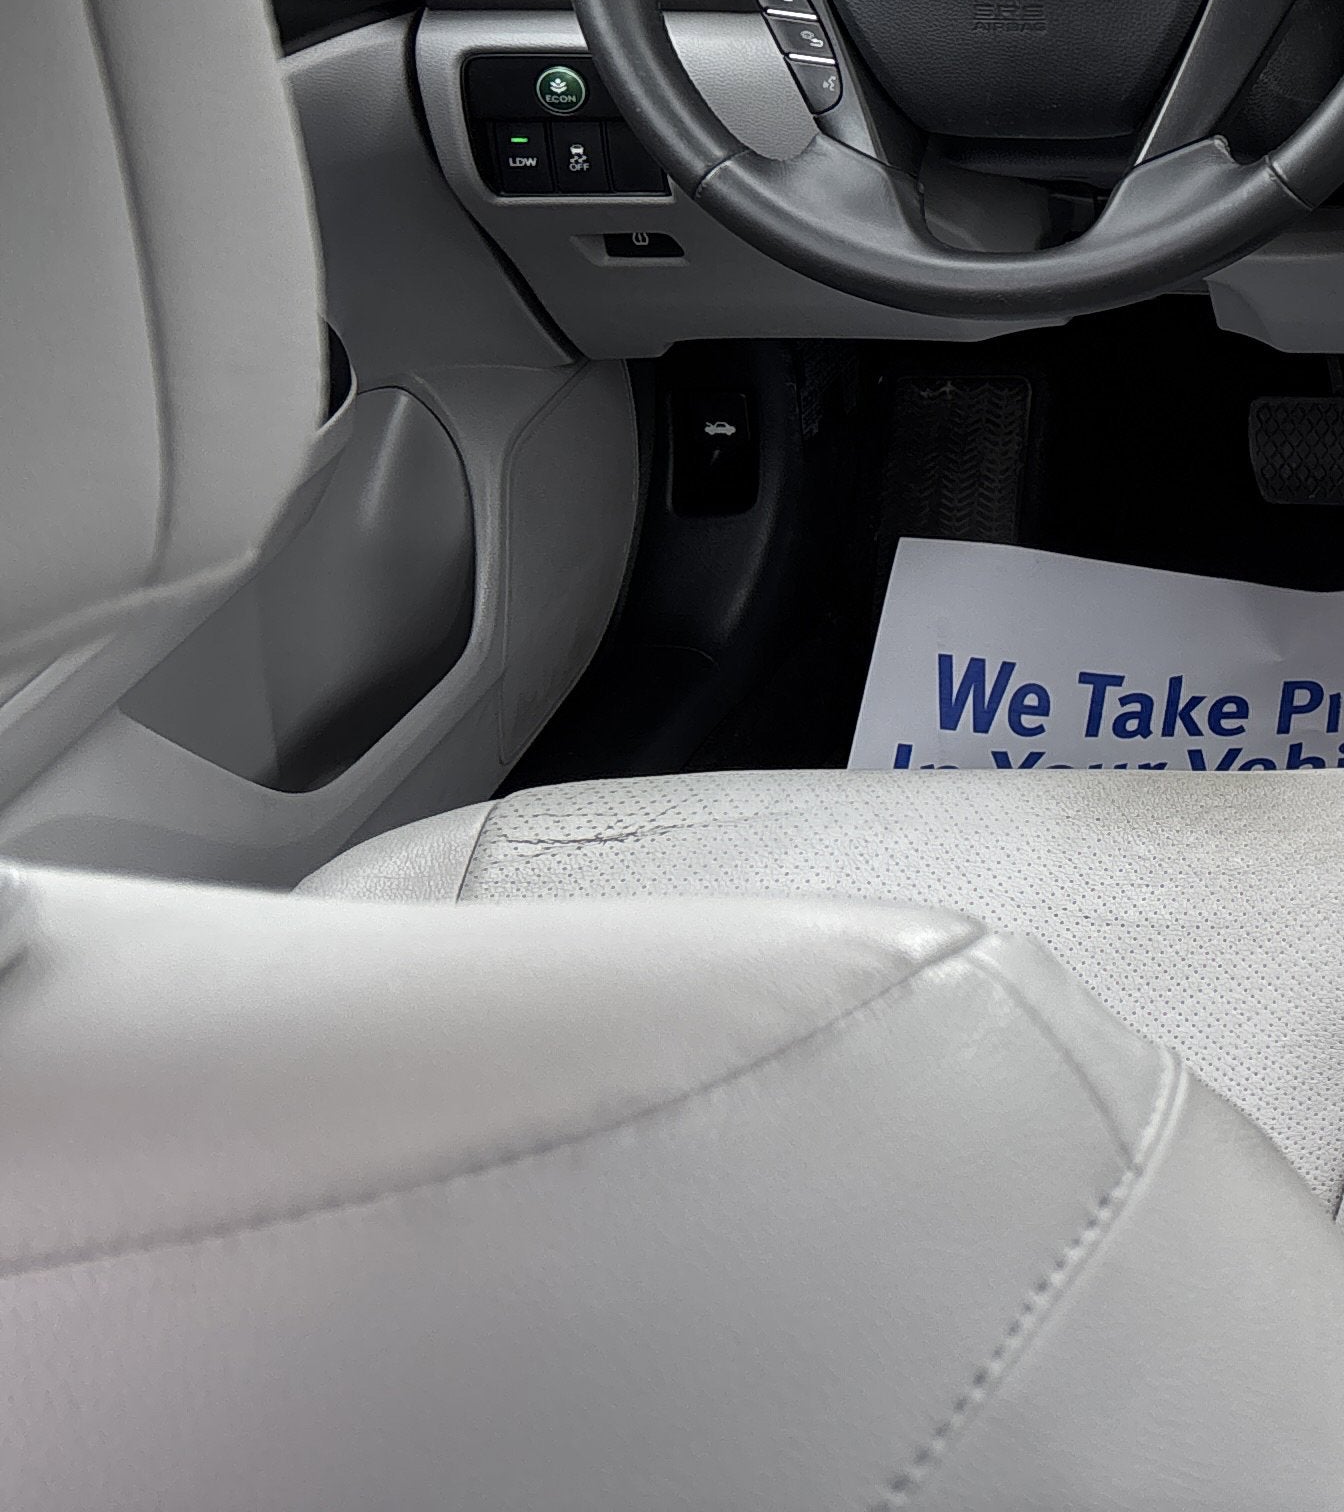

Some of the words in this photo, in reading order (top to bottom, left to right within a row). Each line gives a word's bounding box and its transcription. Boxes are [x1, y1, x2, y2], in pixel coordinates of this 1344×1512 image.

[545, 94, 577, 103] ECON
[508, 157, 538, 167] LDW
[569, 163, 590, 172] OFF
[936, 653, 1052, 738] We
[1077, 670, 1251, 742] Take
